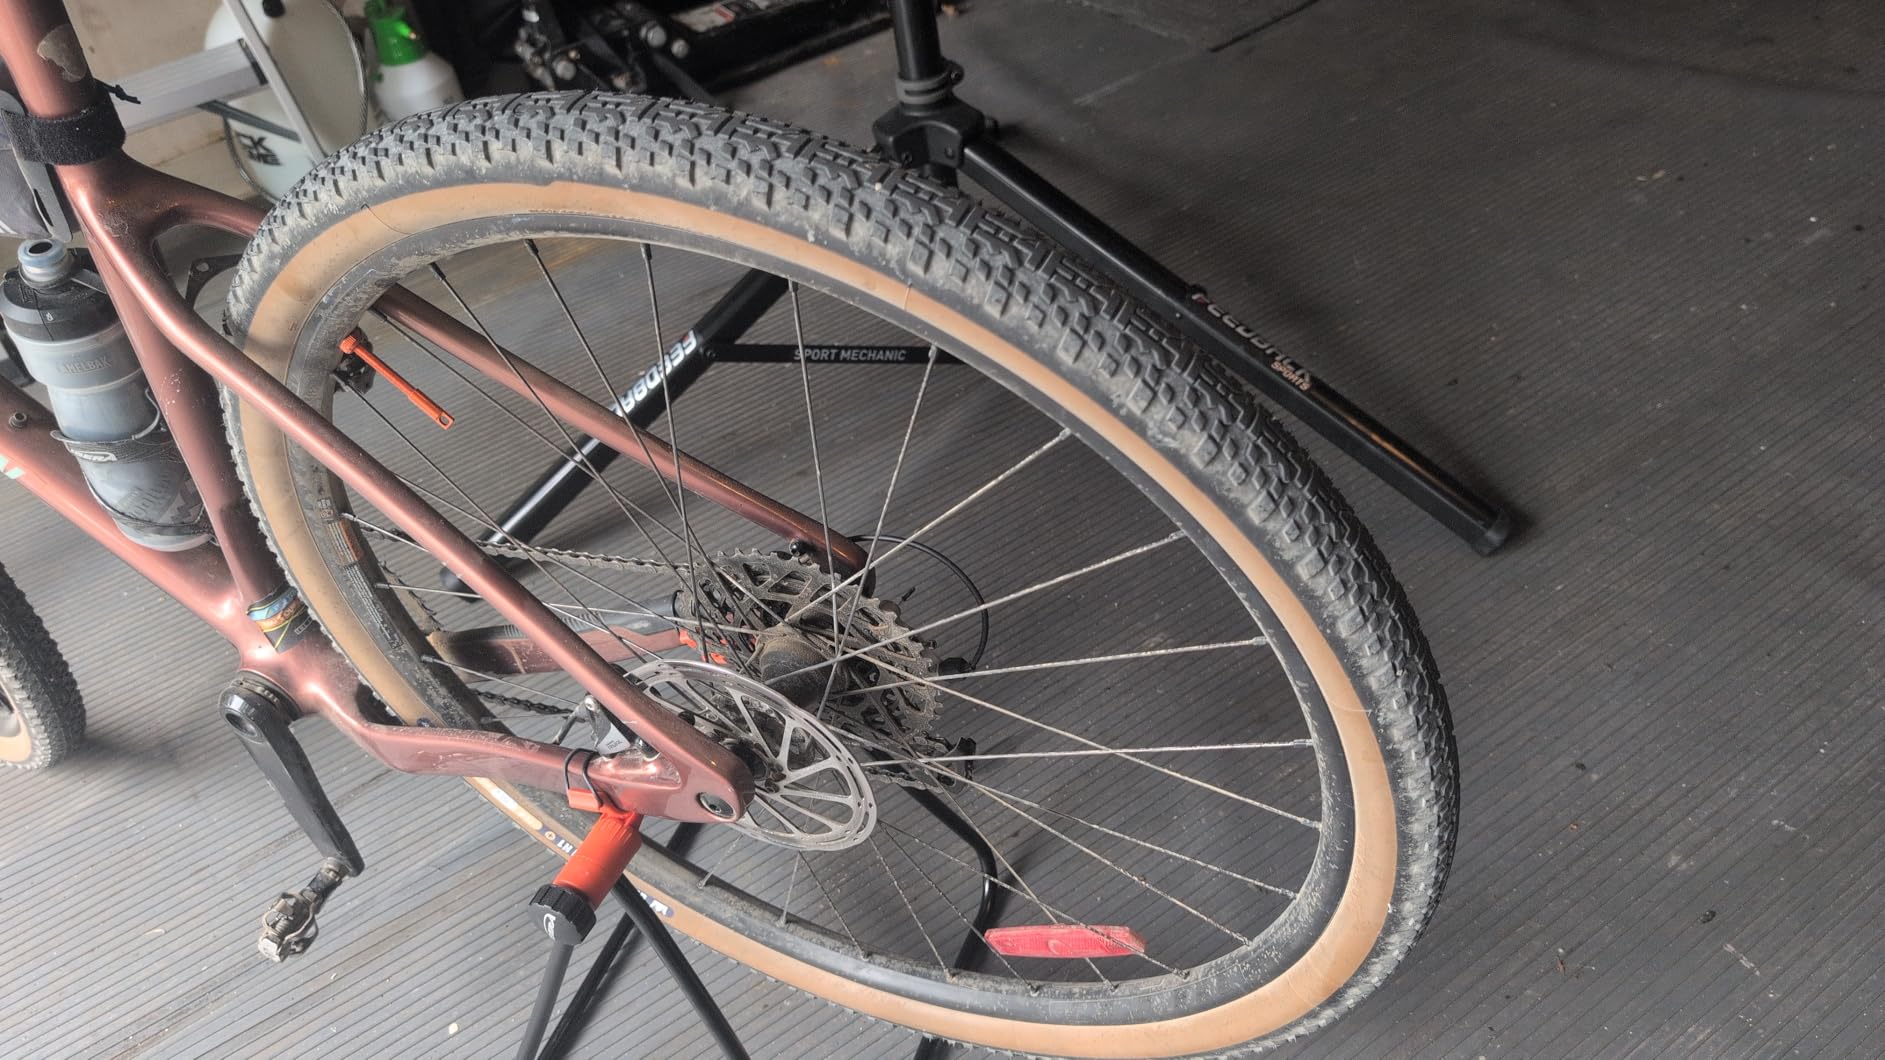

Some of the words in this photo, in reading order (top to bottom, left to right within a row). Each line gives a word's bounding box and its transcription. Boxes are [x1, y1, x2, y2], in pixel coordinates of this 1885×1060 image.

[793, 348, 839, 361] SPORT
[840, 349, 907, 361] MECHANIC
[57, 355, 112, 376] AMELBAK
[1270, 360, 1312, 391] SPORTS
